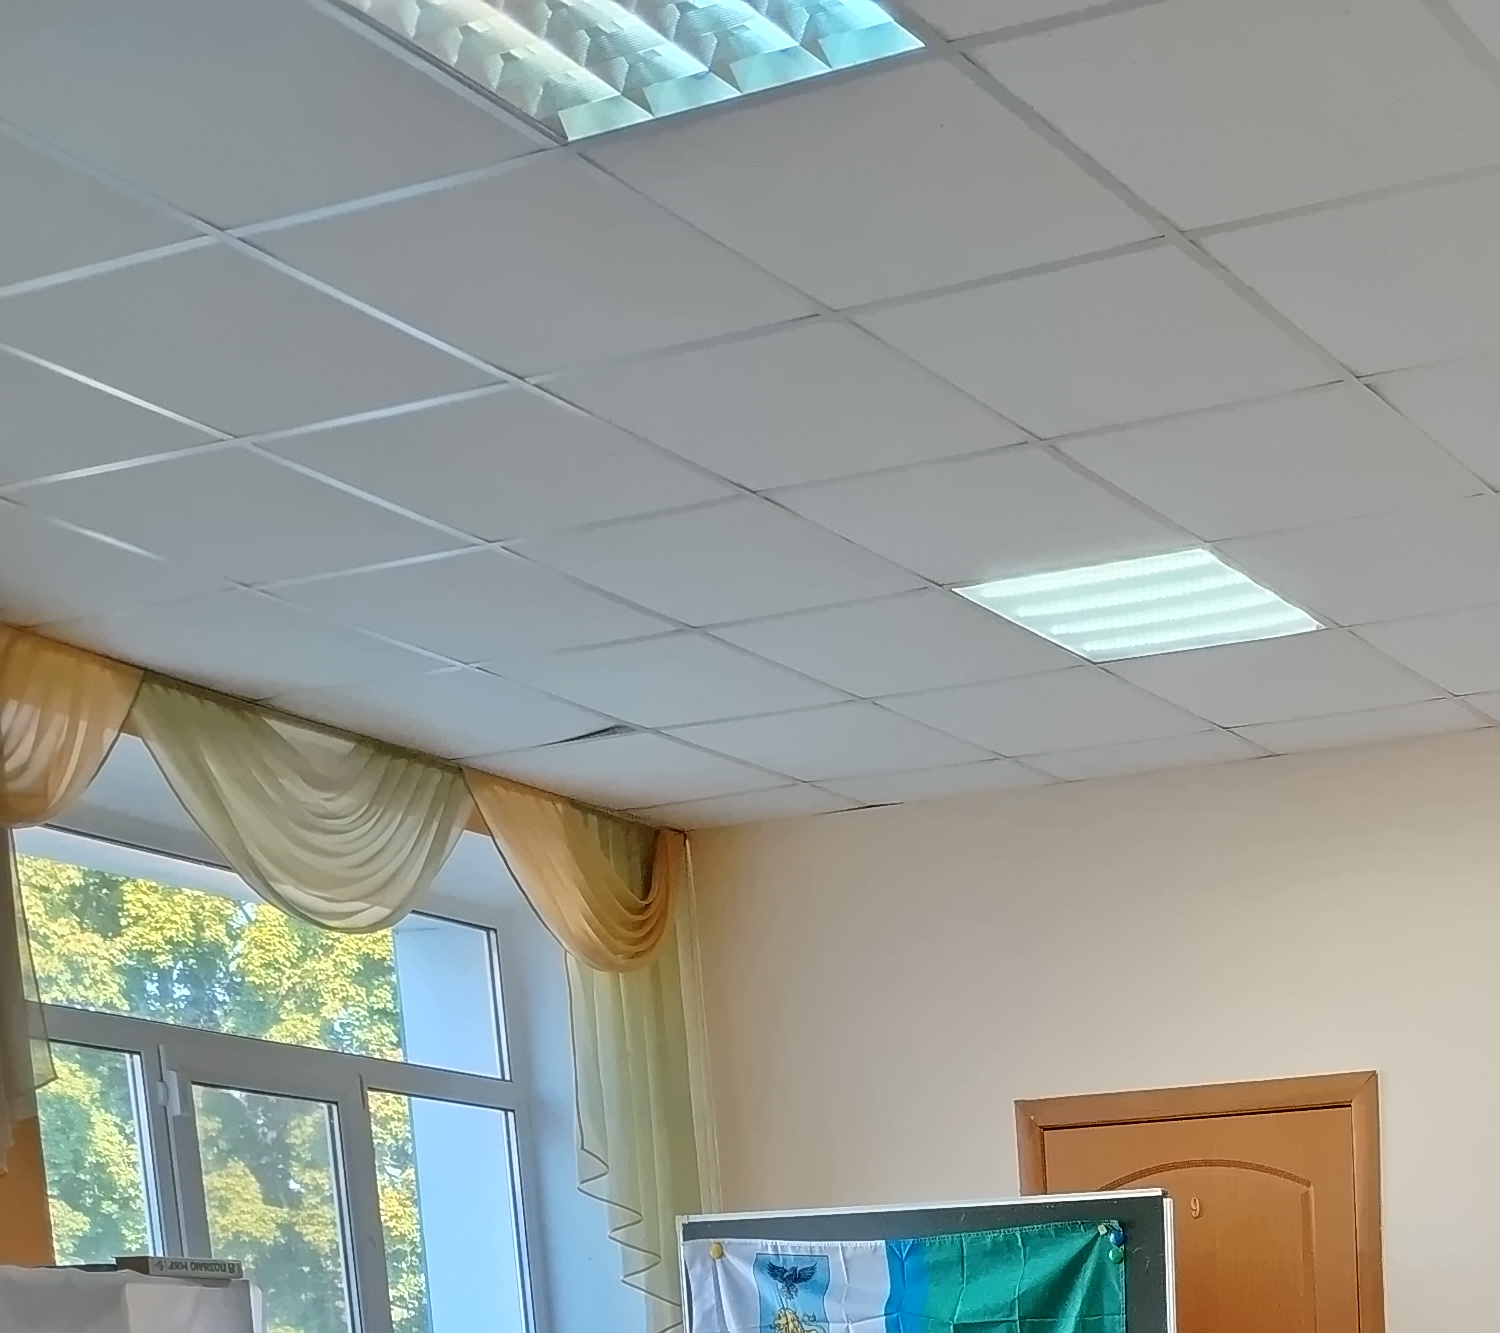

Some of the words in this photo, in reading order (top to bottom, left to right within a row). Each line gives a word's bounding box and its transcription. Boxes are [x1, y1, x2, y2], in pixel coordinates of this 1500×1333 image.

[1190, 1197, 1200, 1218] 9
[168, 1260, 188, 1271] МИР
[190, 1261, 227, 1273] ПОЗНАЮ
[228, 1262, 235, 1273] Я
